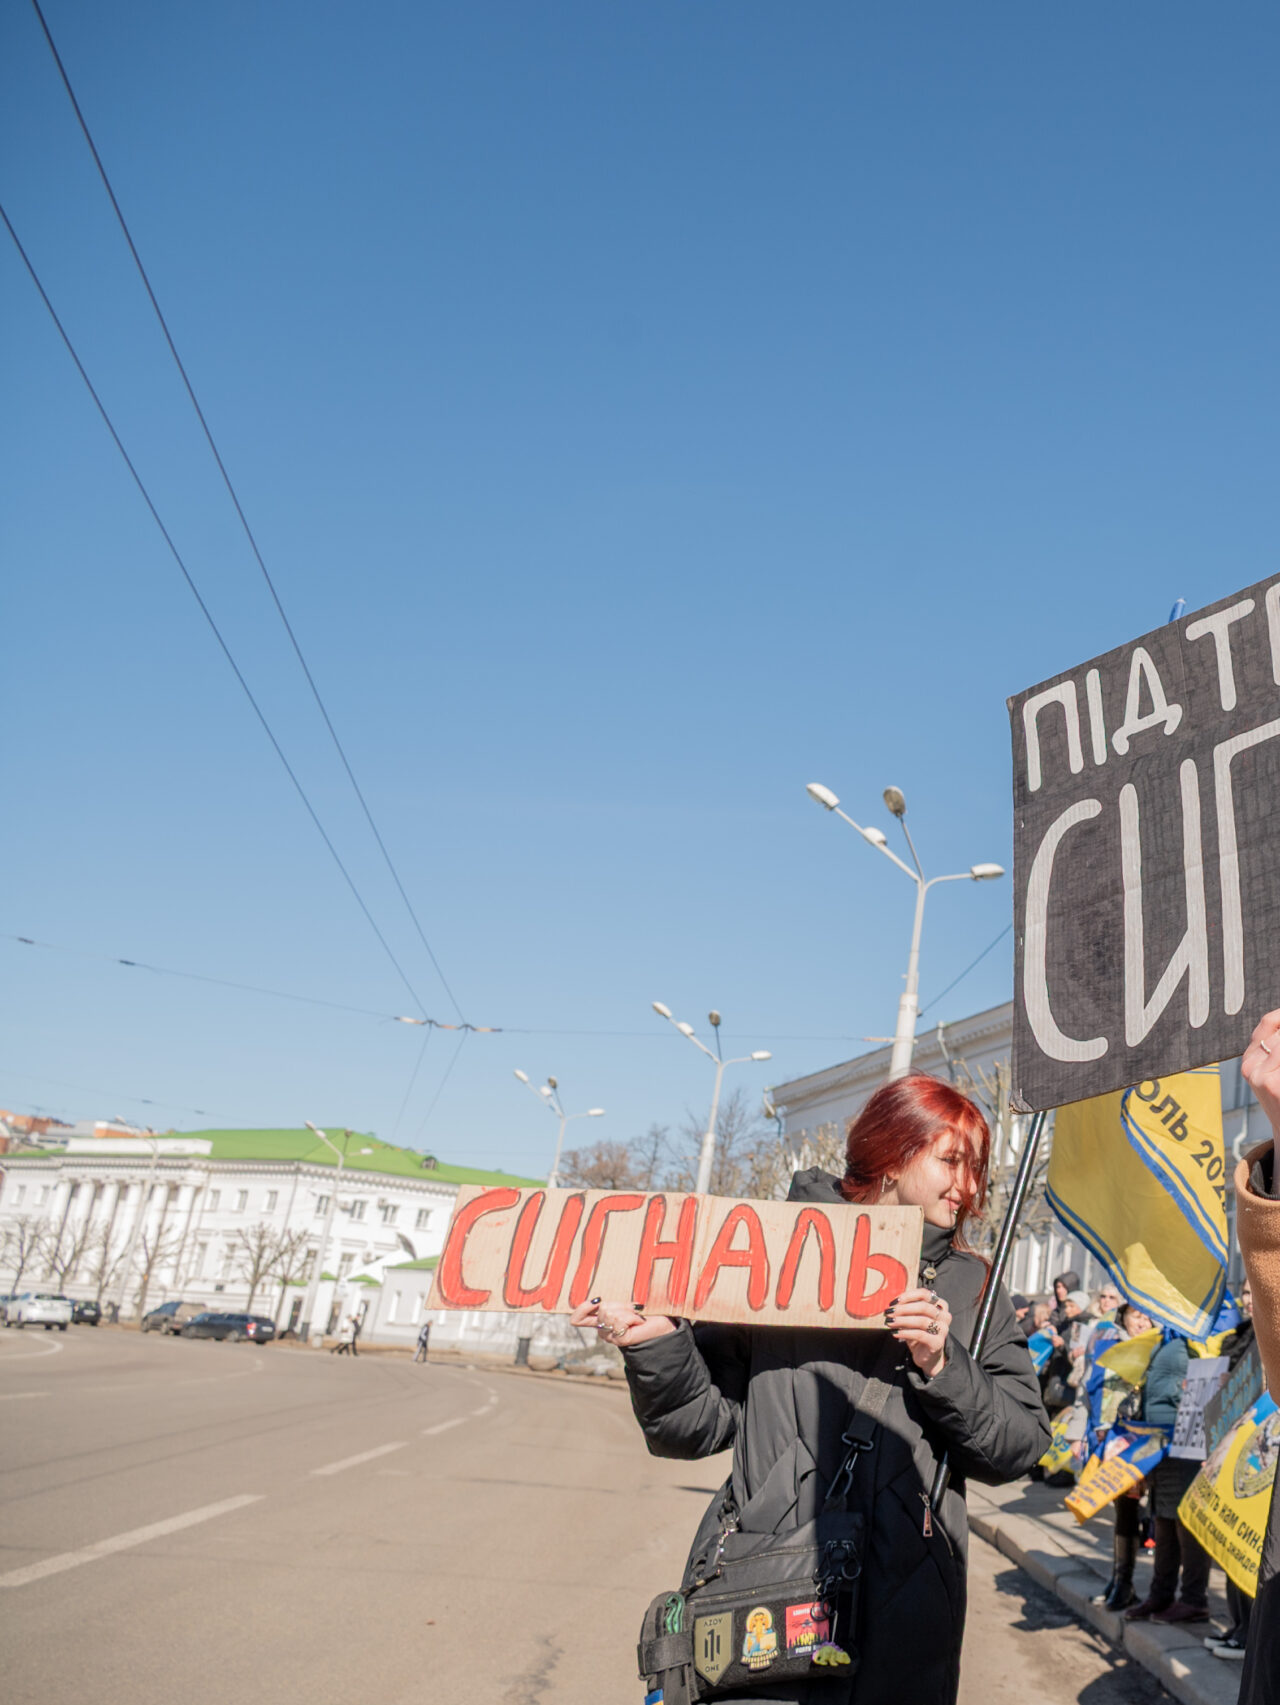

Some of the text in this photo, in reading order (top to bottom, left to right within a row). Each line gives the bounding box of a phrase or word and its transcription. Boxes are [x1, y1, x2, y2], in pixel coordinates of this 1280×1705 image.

[437, 1187, 908, 1319] СИГНАЛЬ
[703, 1617, 723, 1627] AZOV
[704, 1663, 720, 1673] ONE
